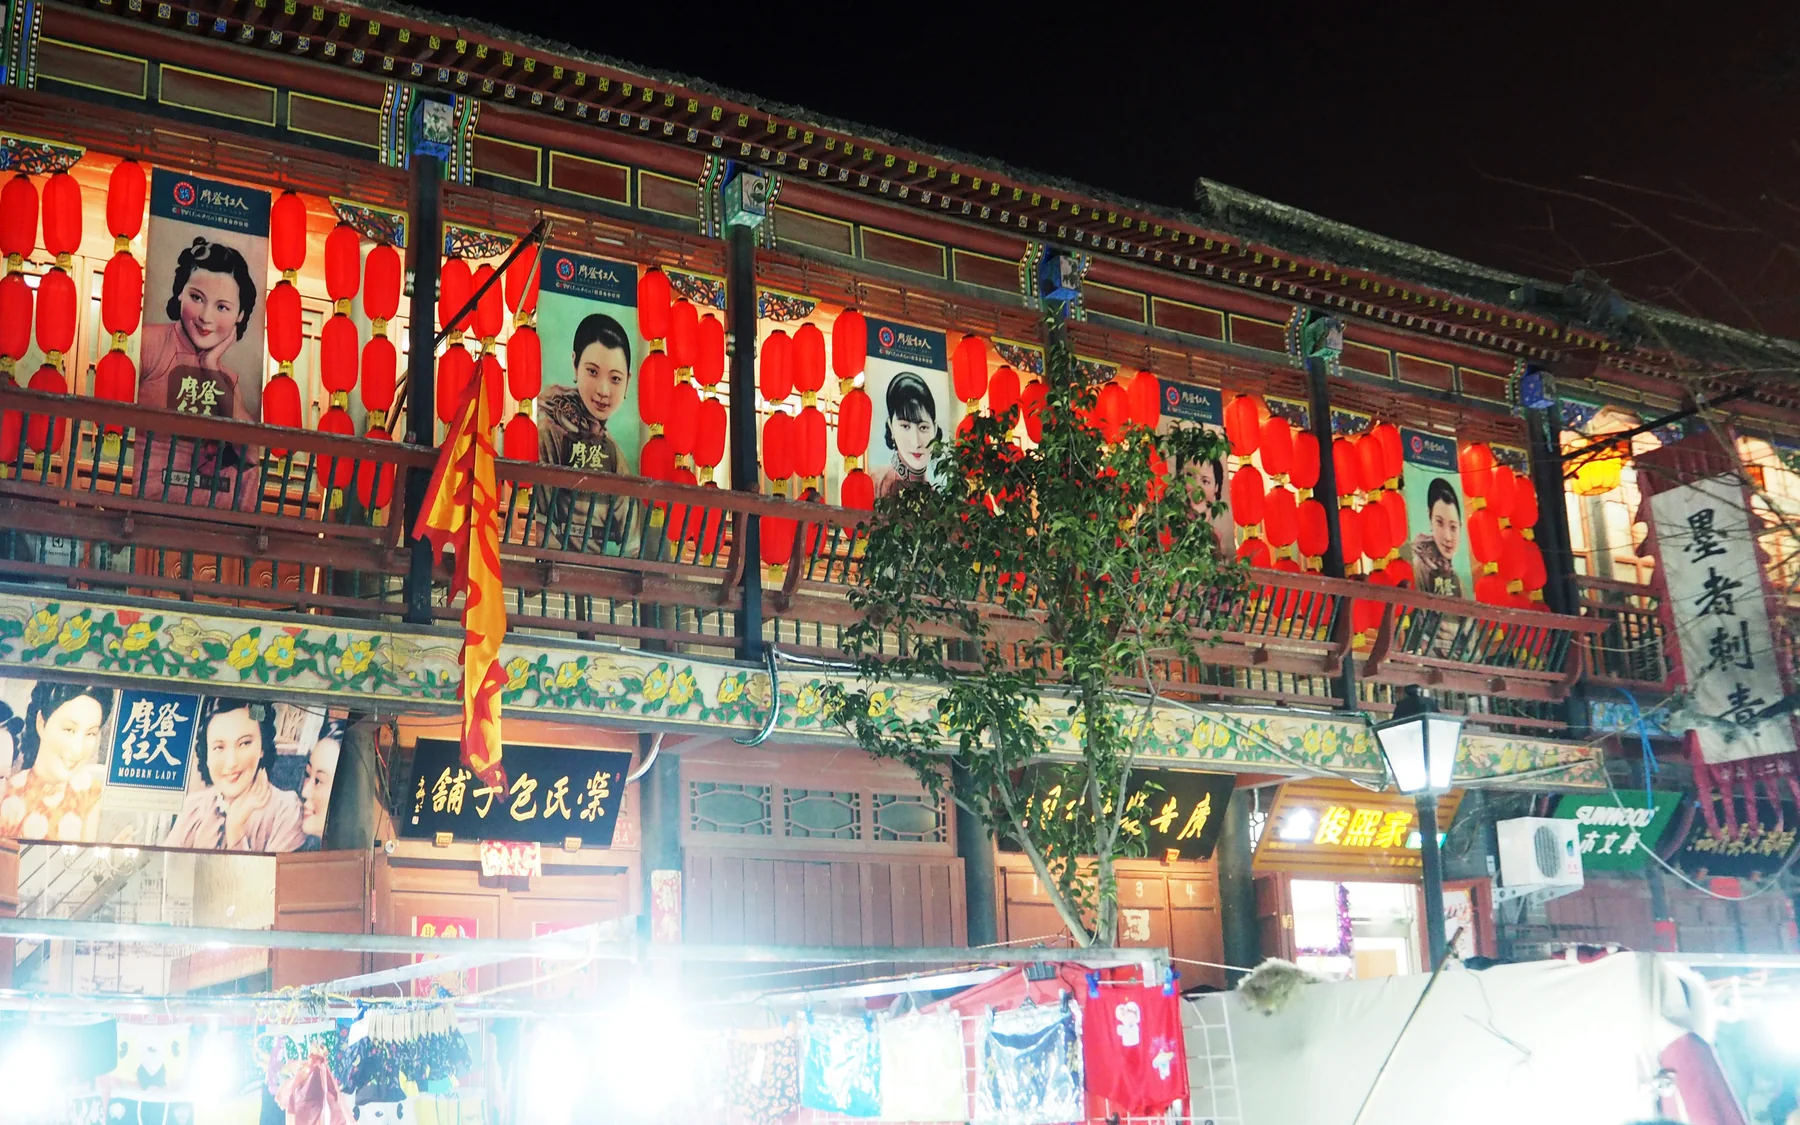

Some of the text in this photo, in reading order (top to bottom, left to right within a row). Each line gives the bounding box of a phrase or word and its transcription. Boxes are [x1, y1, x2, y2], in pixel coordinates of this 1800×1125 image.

[200, 189, 249, 211] 摩登红人
[176, 375, 225, 405] 摩登
[569, 441, 609, 468] 摩登
[121, 698, 189, 739] 摩登
[121, 733, 182, 767] 红人
[118, 767, 177, 780] MODERN LADY
[1313, 805, 1414, 849] 俊熙家
[1135, 880, 1144, 898] 3
[1185, 883, 1196, 900] 4
